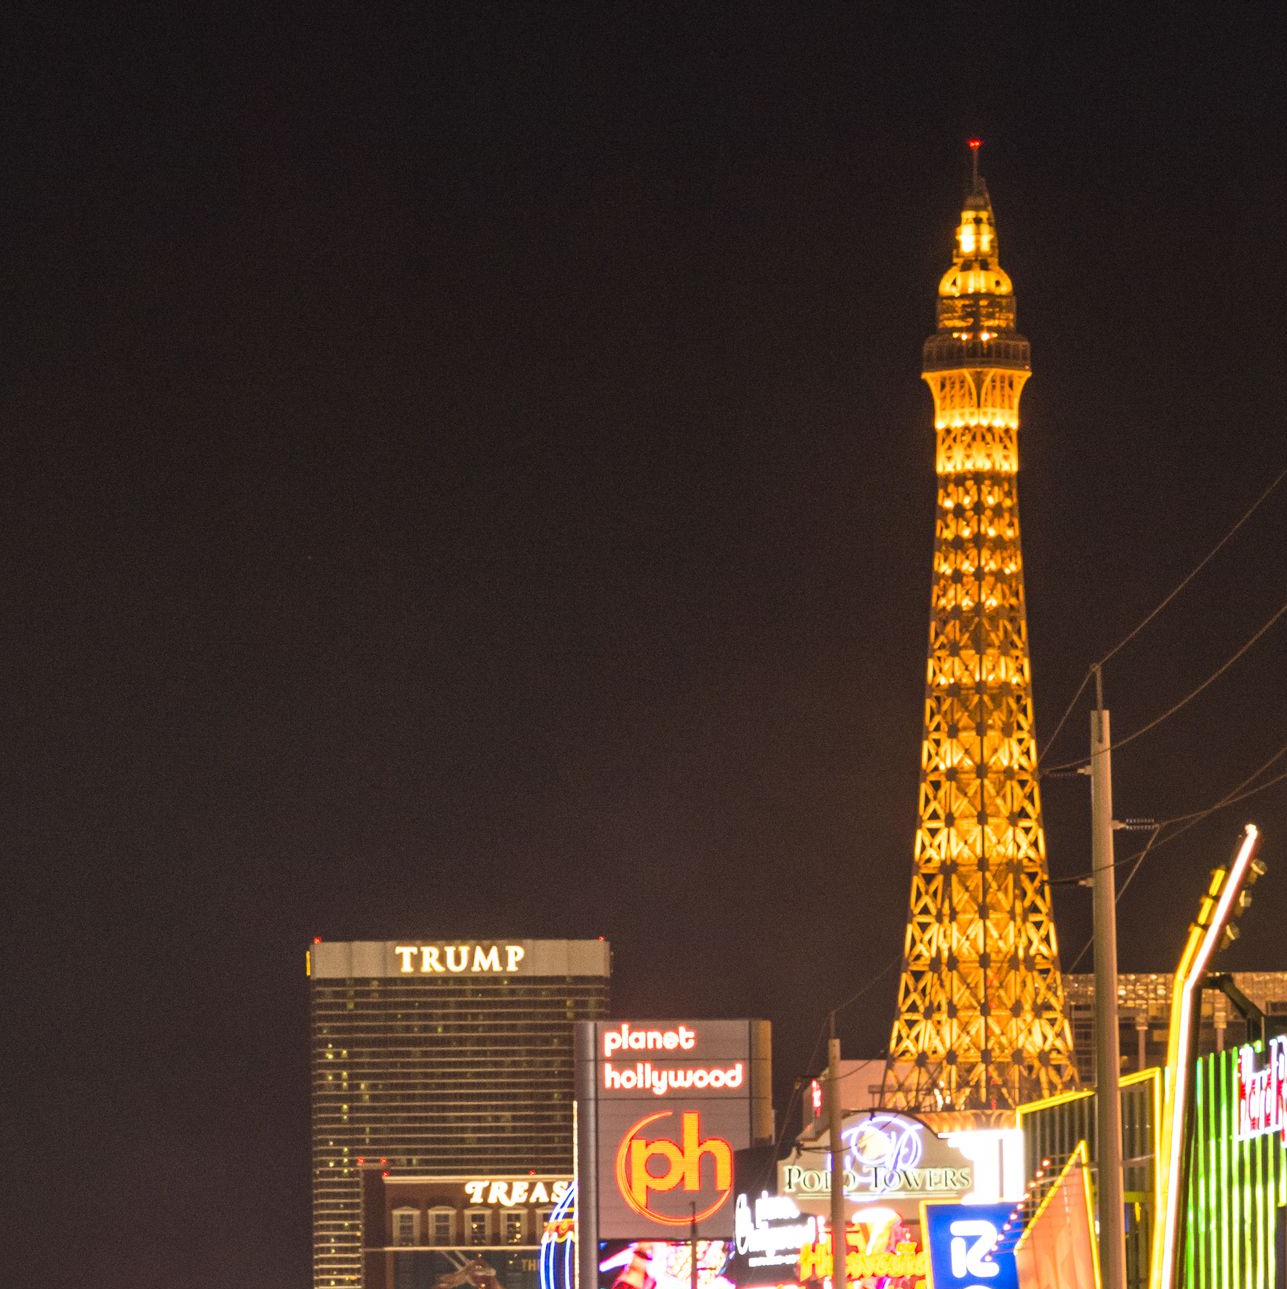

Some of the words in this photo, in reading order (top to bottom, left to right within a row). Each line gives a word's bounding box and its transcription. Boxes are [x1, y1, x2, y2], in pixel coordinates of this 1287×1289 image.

[395, 946, 526, 974] TRUMP
[603, 1024, 696, 1057] planet
[603, 1062, 744, 1095] hollywood
[872, 1166, 972, 1190] TOWERS
[465, 1181, 574, 1207] TREAS
